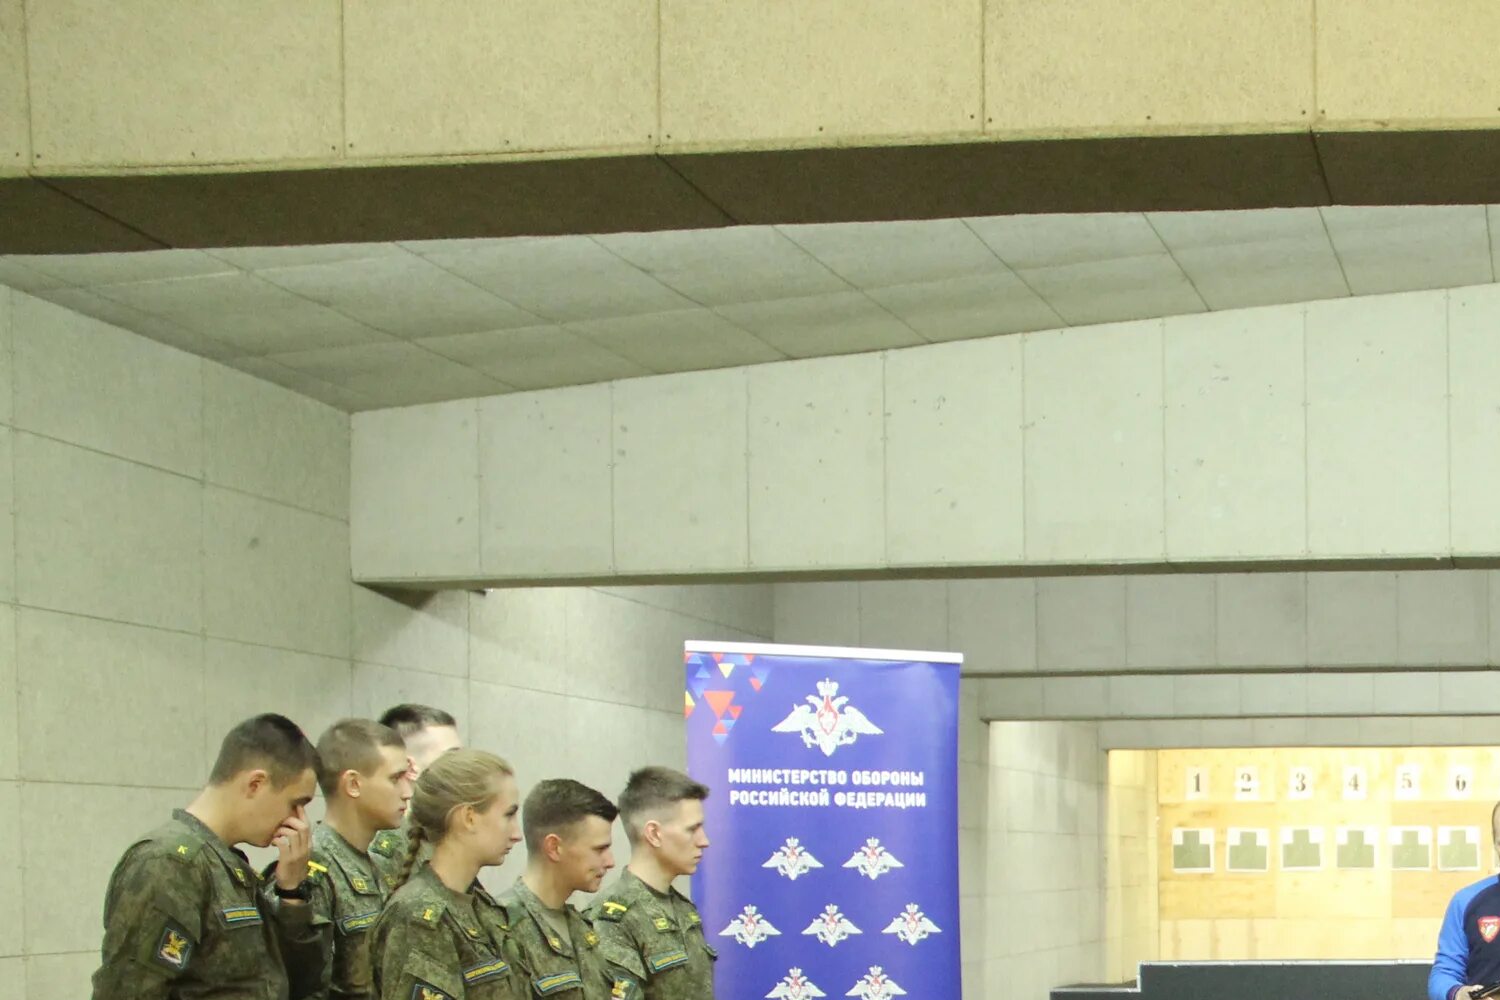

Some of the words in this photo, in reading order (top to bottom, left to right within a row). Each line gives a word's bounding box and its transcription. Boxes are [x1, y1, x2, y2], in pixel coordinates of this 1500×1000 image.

[728, 768, 847, 785] МИНИСТЕРСТВО
[852, 770, 924, 786] ОБОРОНЫ
[1193, 773, 1201, 793] 1
[1240, 773, 1252, 793] 2
[1295, 773, 1307, 792] 3
[1348, 773, 1360, 792] 4
[1401, 772, 1413, 790] 5
[1455, 774, 1467, 792] 6
[729, 788, 830, 806] РОССИЙСКОЙ
[834, 792, 927, 809] ФЕДЕРАЦИИ
